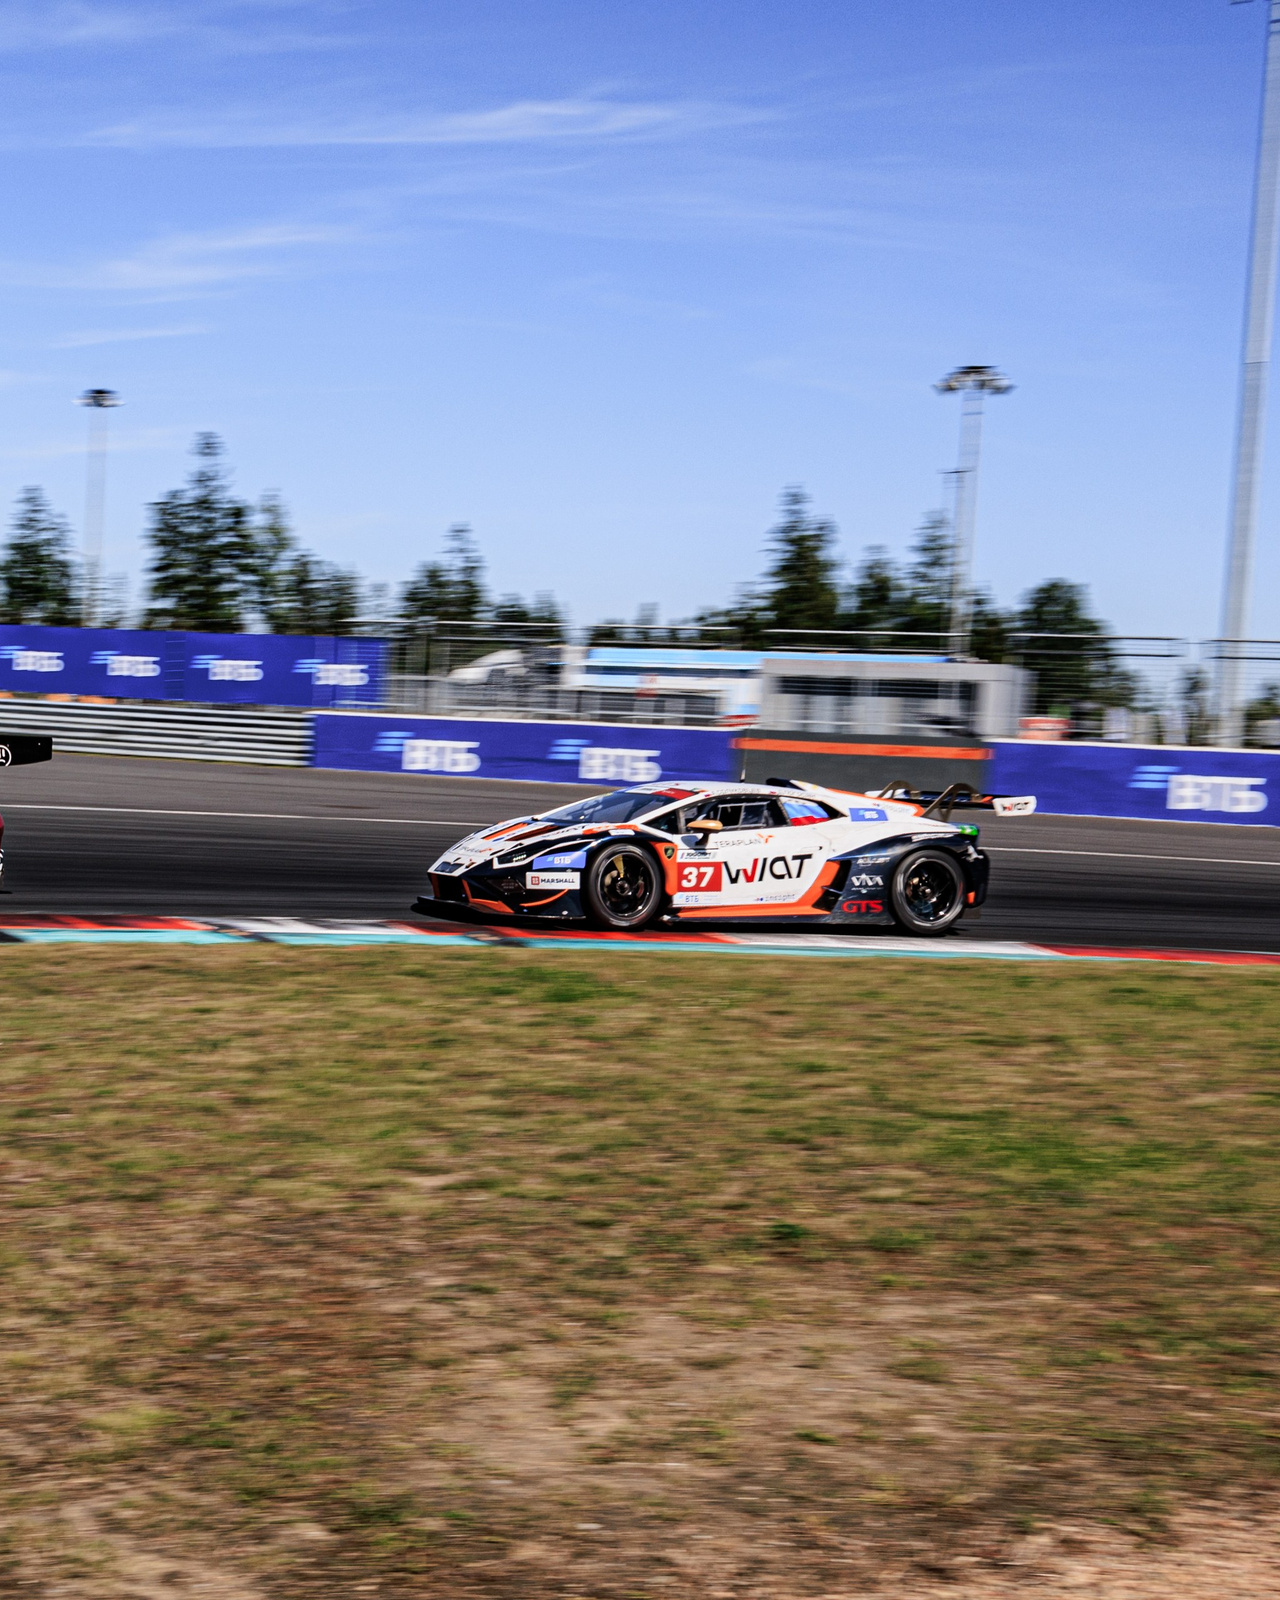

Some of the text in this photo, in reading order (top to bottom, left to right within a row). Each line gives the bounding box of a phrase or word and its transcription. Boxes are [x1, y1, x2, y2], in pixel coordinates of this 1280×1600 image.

[553, 856, 571, 865] ВТБ
[540, 877, 575, 885] MARSHALL
[681, 866, 715, 888] 37
